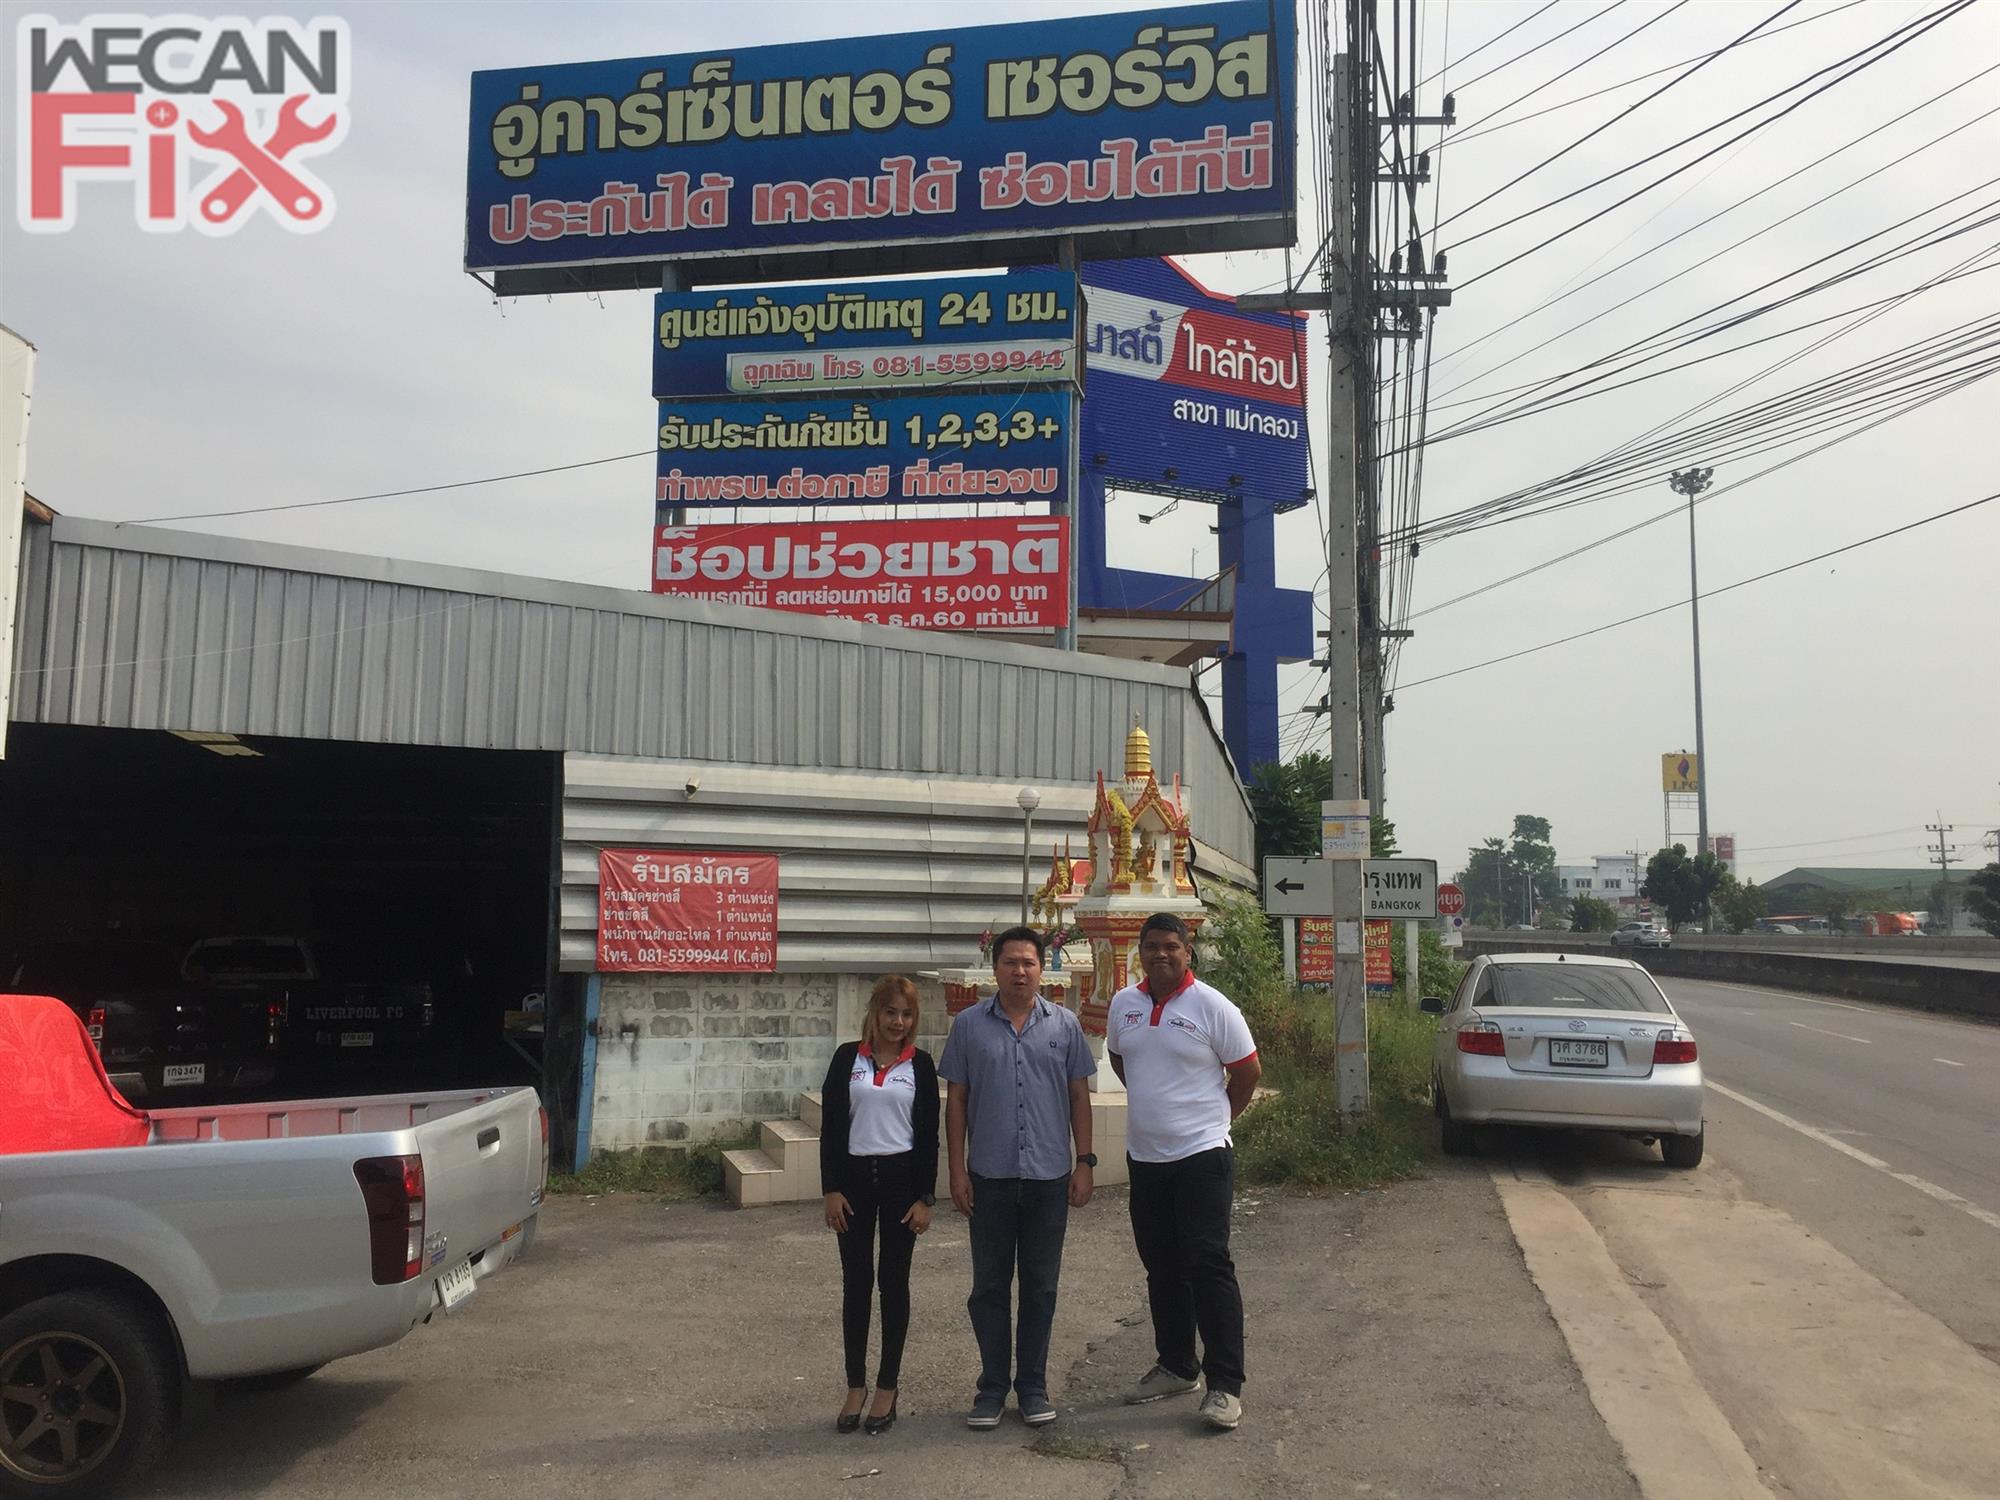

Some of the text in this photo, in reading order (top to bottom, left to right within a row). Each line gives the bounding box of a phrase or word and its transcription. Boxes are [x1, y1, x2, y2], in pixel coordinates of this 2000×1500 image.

[492, 27, 1269, 178] อู่คาร์เซ็นเตอร์ เซอร์วิส
[489, 122, 1273, 245] ประกันได้ เคลมได้ ซ่อมได้ที่นี่
[660, 290, 1067, 348] ศูนย์แจ้งอุบัติเหตุ 24 ชม.
[743, 349, 1064, 388] ฉุกเฉิน โทร 081-5599944
[658, 404, 1059, 450] รับประกันภัยชั้น 1,2,3,3+
[1173, 399, 1298, 439] สาขา แม่กลอง
[657, 459, 1057, 500] ทำพรบ.ต่อภาษี ที่เดียวจบ
[776, 583, 912, 605] ลดหย่อนภาษีได้
[921, 584, 1000, 606] 15,000
[1010, 585, 1048, 601] บาท
[888, 612, 965, 626] ธ.ค.60
[976, 602, 1038, 625] เท่านั้น
[632, 855, 750, 884] รับสมัคร
[604, 887, 774, 904] รับสมัครช่างสี 3 ตำแหน่ง
[1371, 900, 1421, 910] BANGKOK
[716, 910, 722, 922] 1
[726, 907, 772, 922] ตำแหน่ง
[716, 929, 721, 941] 1
[726, 927, 772, 942] ตำแหน่ง
[603, 945, 632, 962] โทร.
[638, 949, 728, 962] 081-5599944
[305, 1006, 404, 1020] LIVERPOOL FC
[1575, 1043, 1604, 1056] 3786
